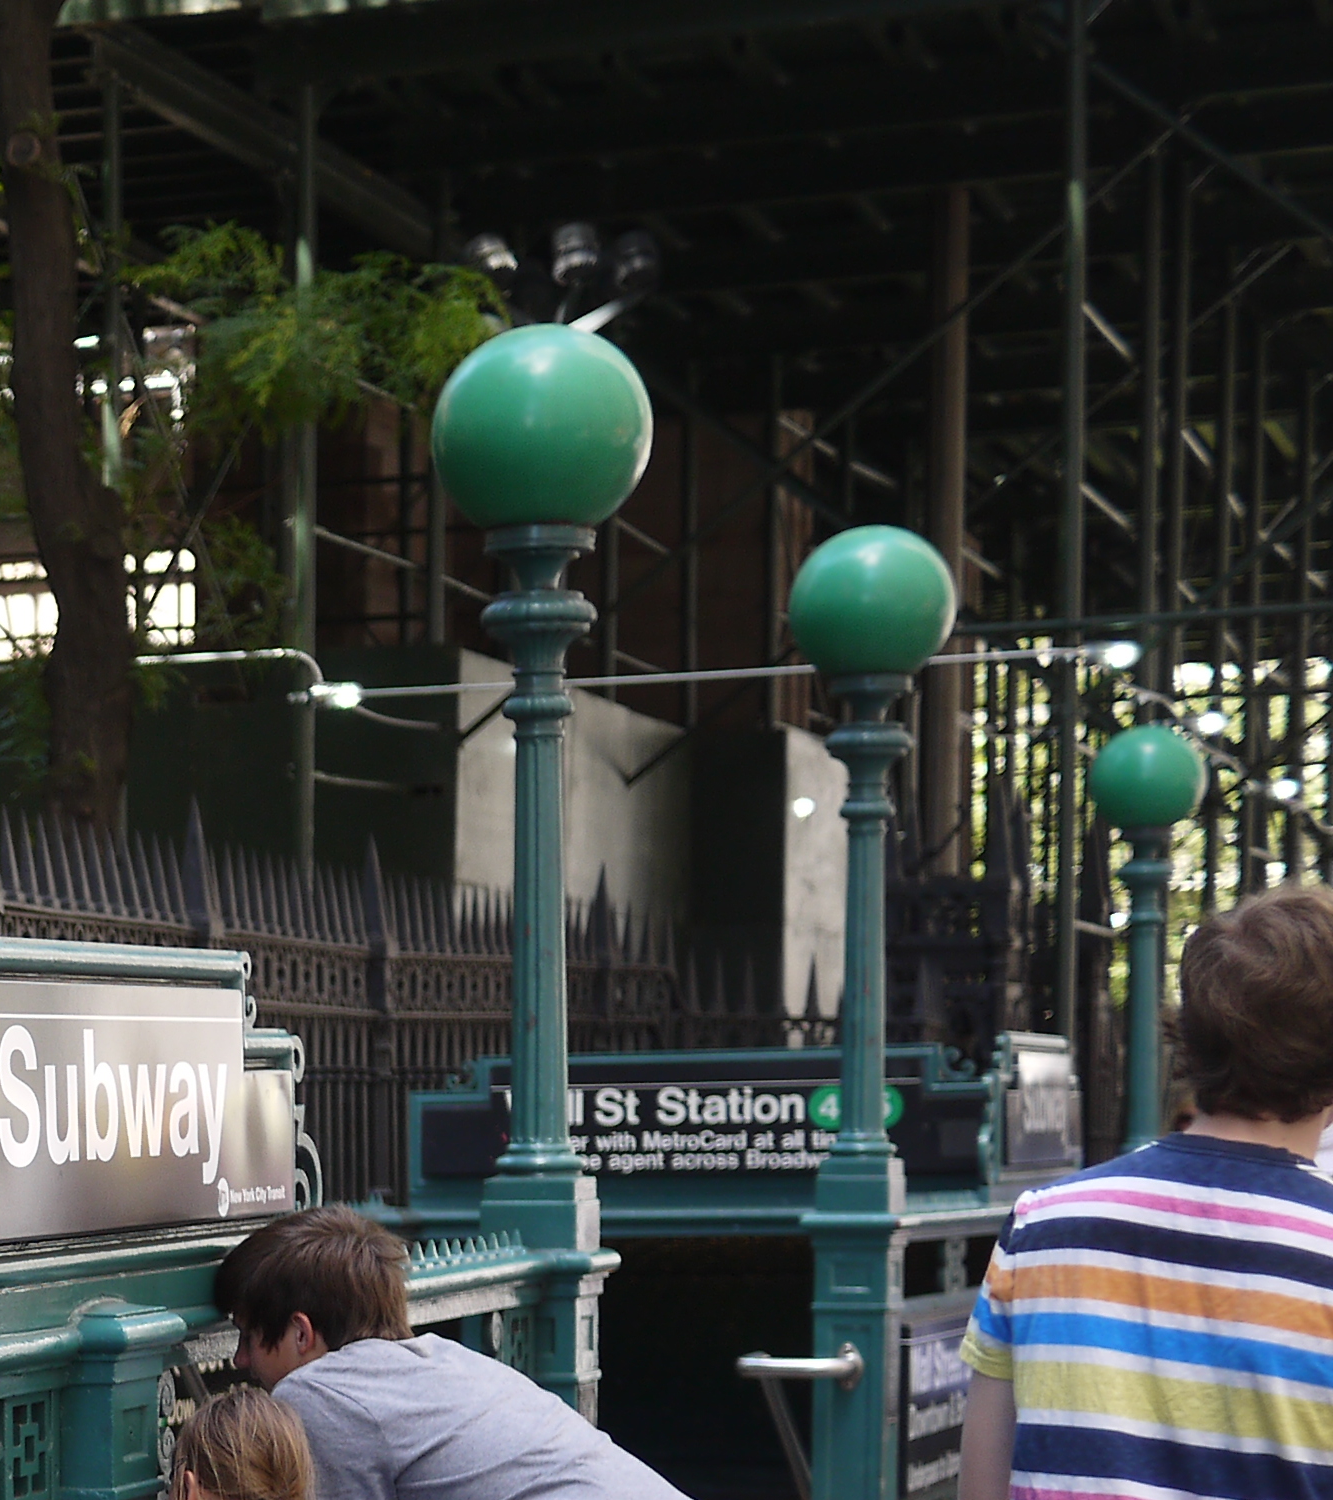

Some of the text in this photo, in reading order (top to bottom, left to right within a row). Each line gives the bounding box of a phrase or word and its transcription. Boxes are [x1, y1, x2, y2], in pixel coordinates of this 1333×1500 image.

[594, 1087, 640, 1127] St
[656, 1086, 805, 1127] Station
[596, 1131, 636, 1151] with
[642, 1130, 747, 1151] MetroCard
[754, 1132, 774, 1151] at
[782, 1130, 805, 1151] all
[608, 1153, 666, 1174] agent
[672, 1154, 739, 1170] across
[255, 1186, 267, 1204] City
[267, 1185, 286, 1201] Transit
